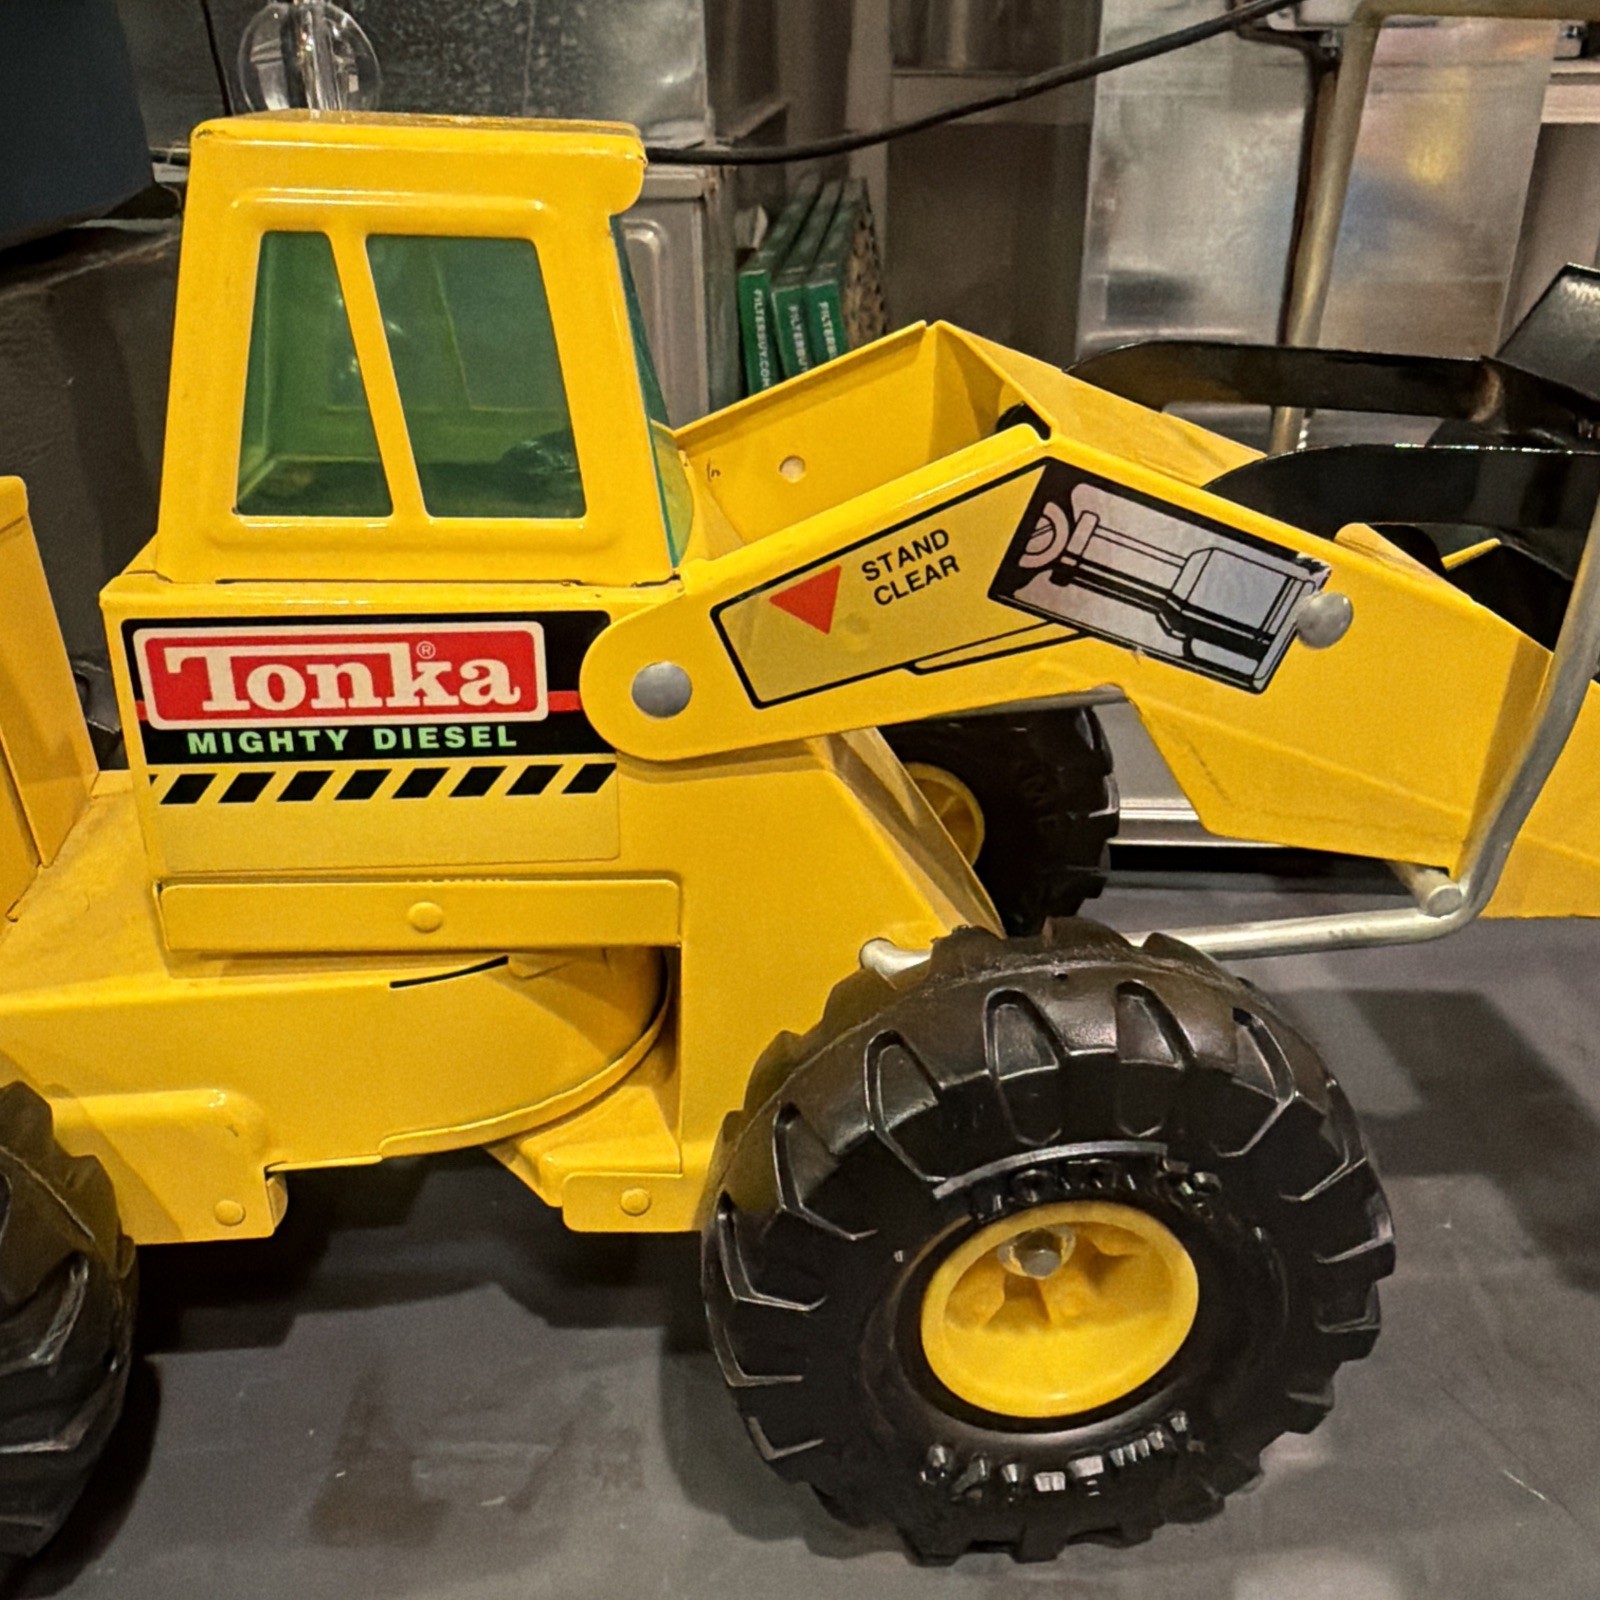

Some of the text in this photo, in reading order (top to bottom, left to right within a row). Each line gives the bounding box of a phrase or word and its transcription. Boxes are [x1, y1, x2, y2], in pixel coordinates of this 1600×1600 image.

[861, 528, 950, 582] STAND
[873, 554, 960, 606] CLEAR
[163, 641, 522, 712] Tonka
[187, 725, 517, 755] MIGHTY DIESEL
